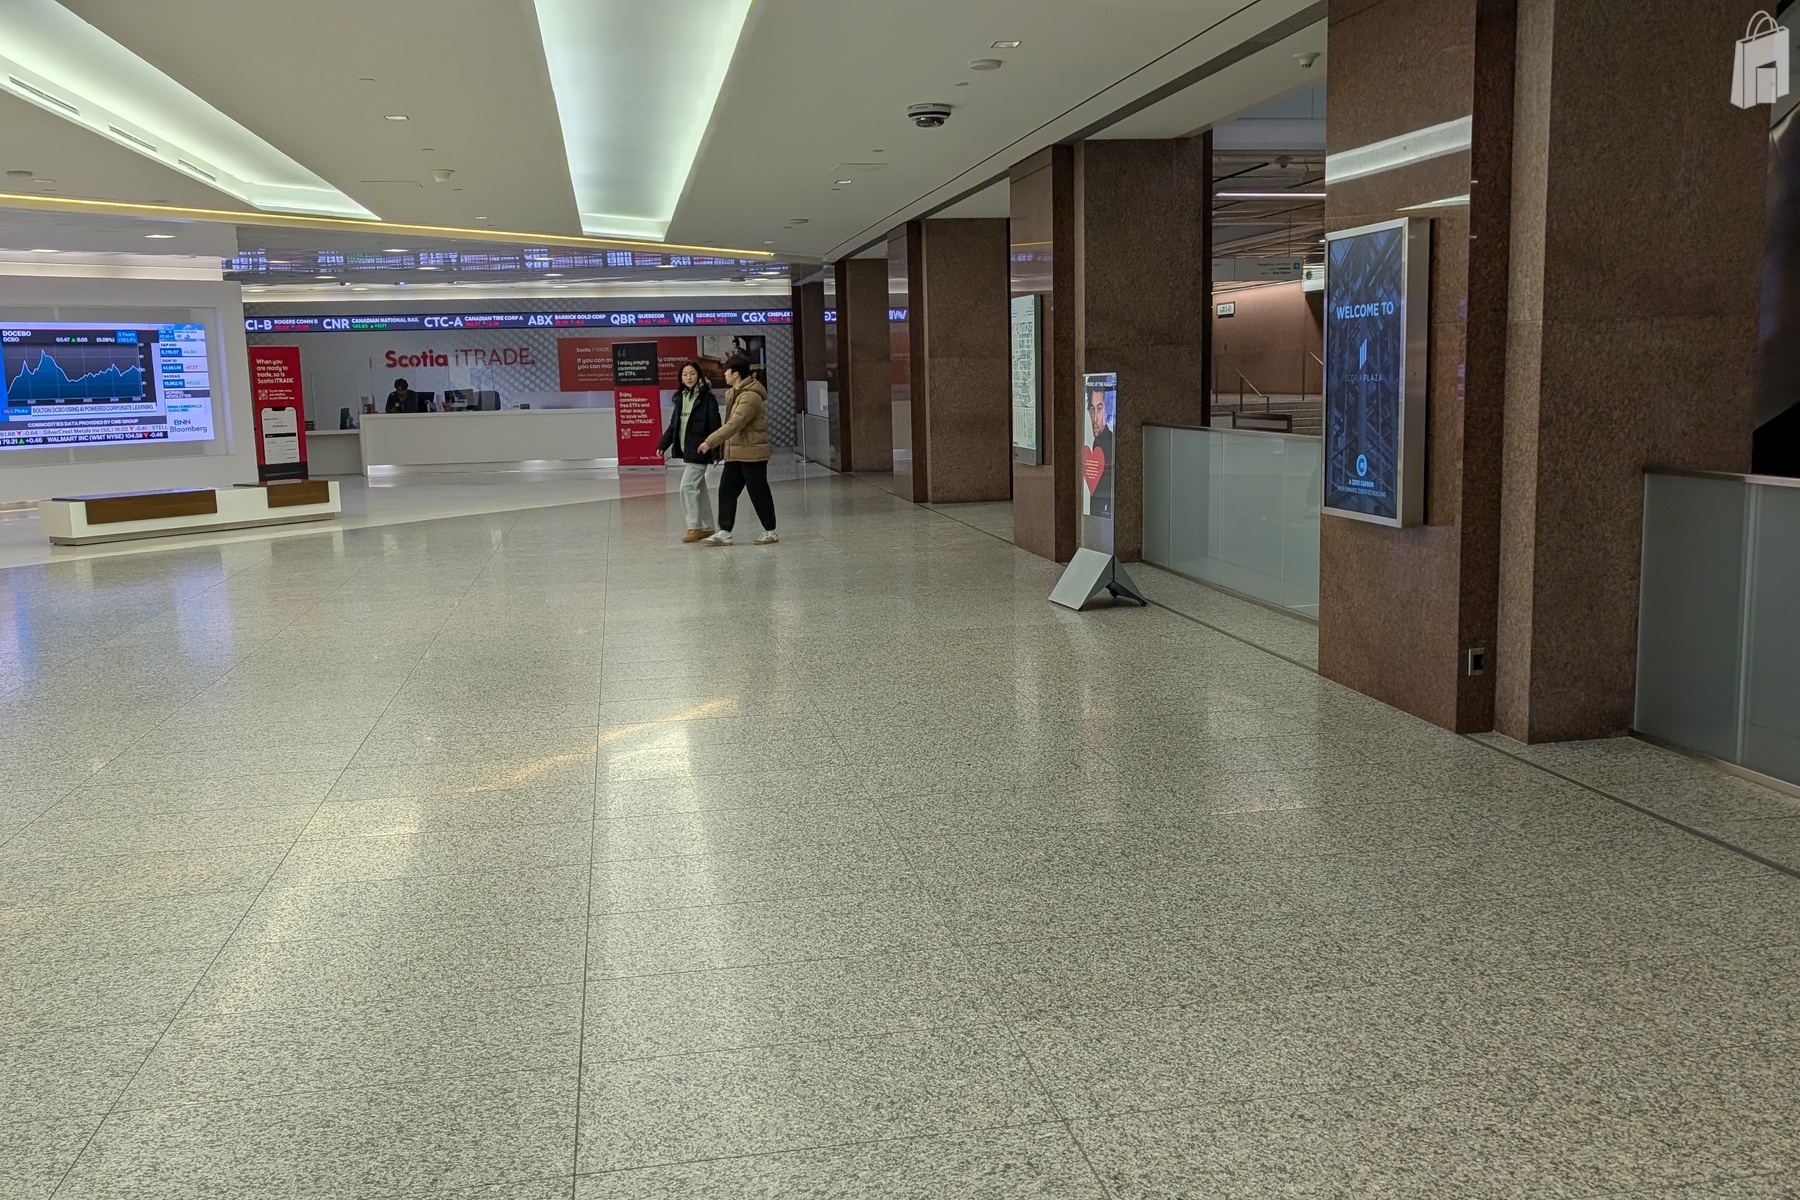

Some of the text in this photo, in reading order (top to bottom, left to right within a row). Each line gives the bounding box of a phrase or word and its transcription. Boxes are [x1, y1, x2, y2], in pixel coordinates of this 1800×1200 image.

[1337, 301, 1394, 319] WELCOME TO
[424, 317, 463, 327] CTC-A
[528, 315, 553, 325] ABX
[611, 314, 636, 325] QBR
[673, 313, 694, 323] WN
[742, 312, 766, 322] CGX
[323, 319, 350, 329] CNR
[385, 348, 535, 368] Scotia iTRADE.
